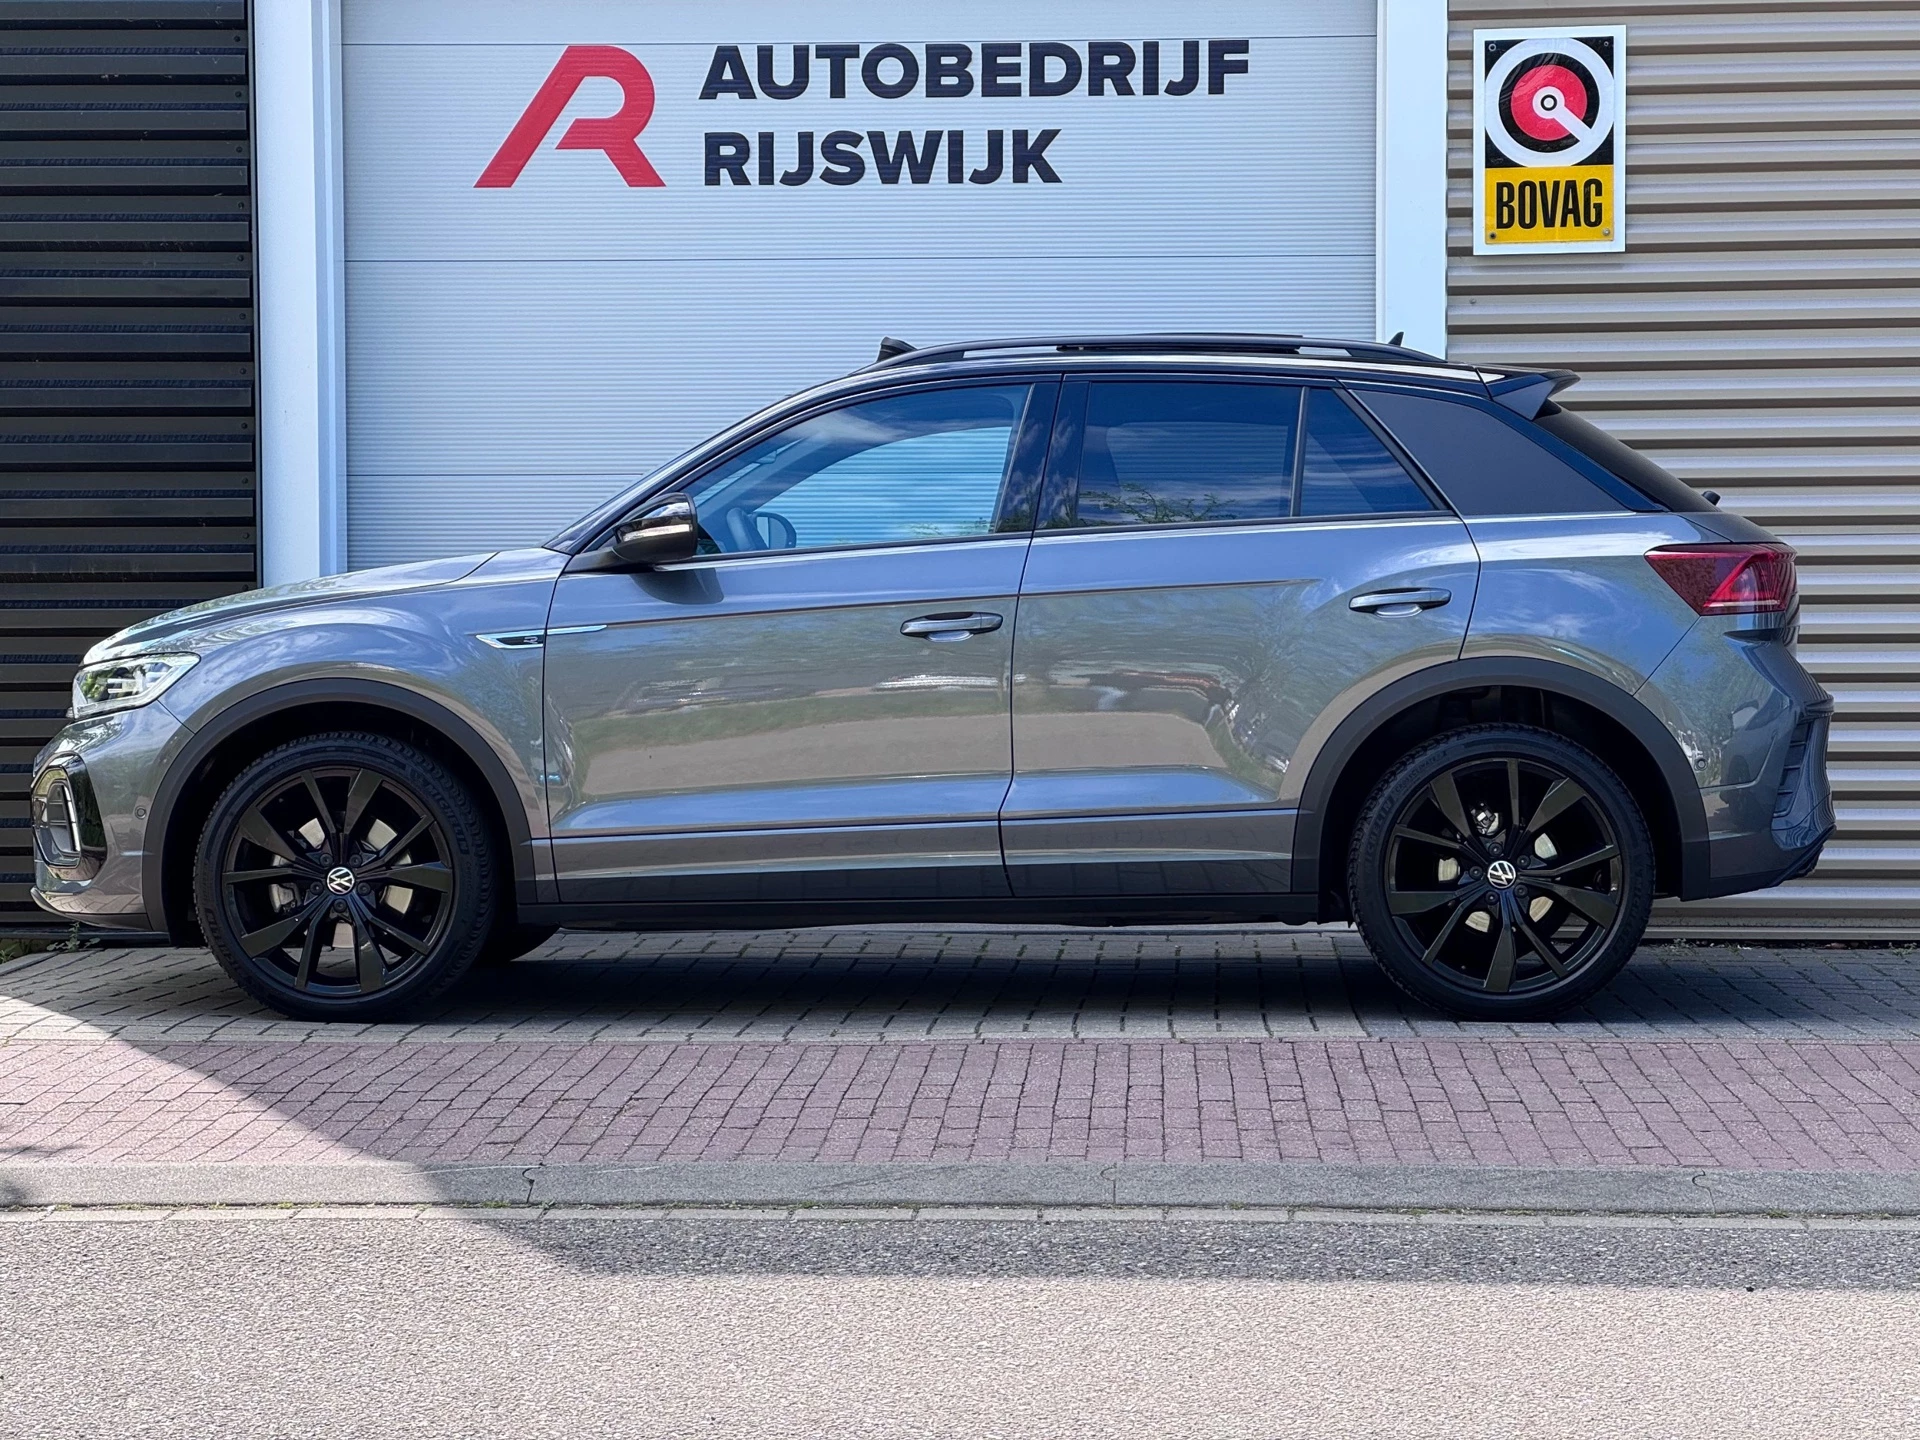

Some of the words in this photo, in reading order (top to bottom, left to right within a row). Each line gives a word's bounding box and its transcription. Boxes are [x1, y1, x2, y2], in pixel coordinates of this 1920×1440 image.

[699, 38, 1249, 100] AUTOBEDRIJF
[704, 128, 1062, 187] RIJSWIJK
[1495, 178, 1603, 229] BOVAG
